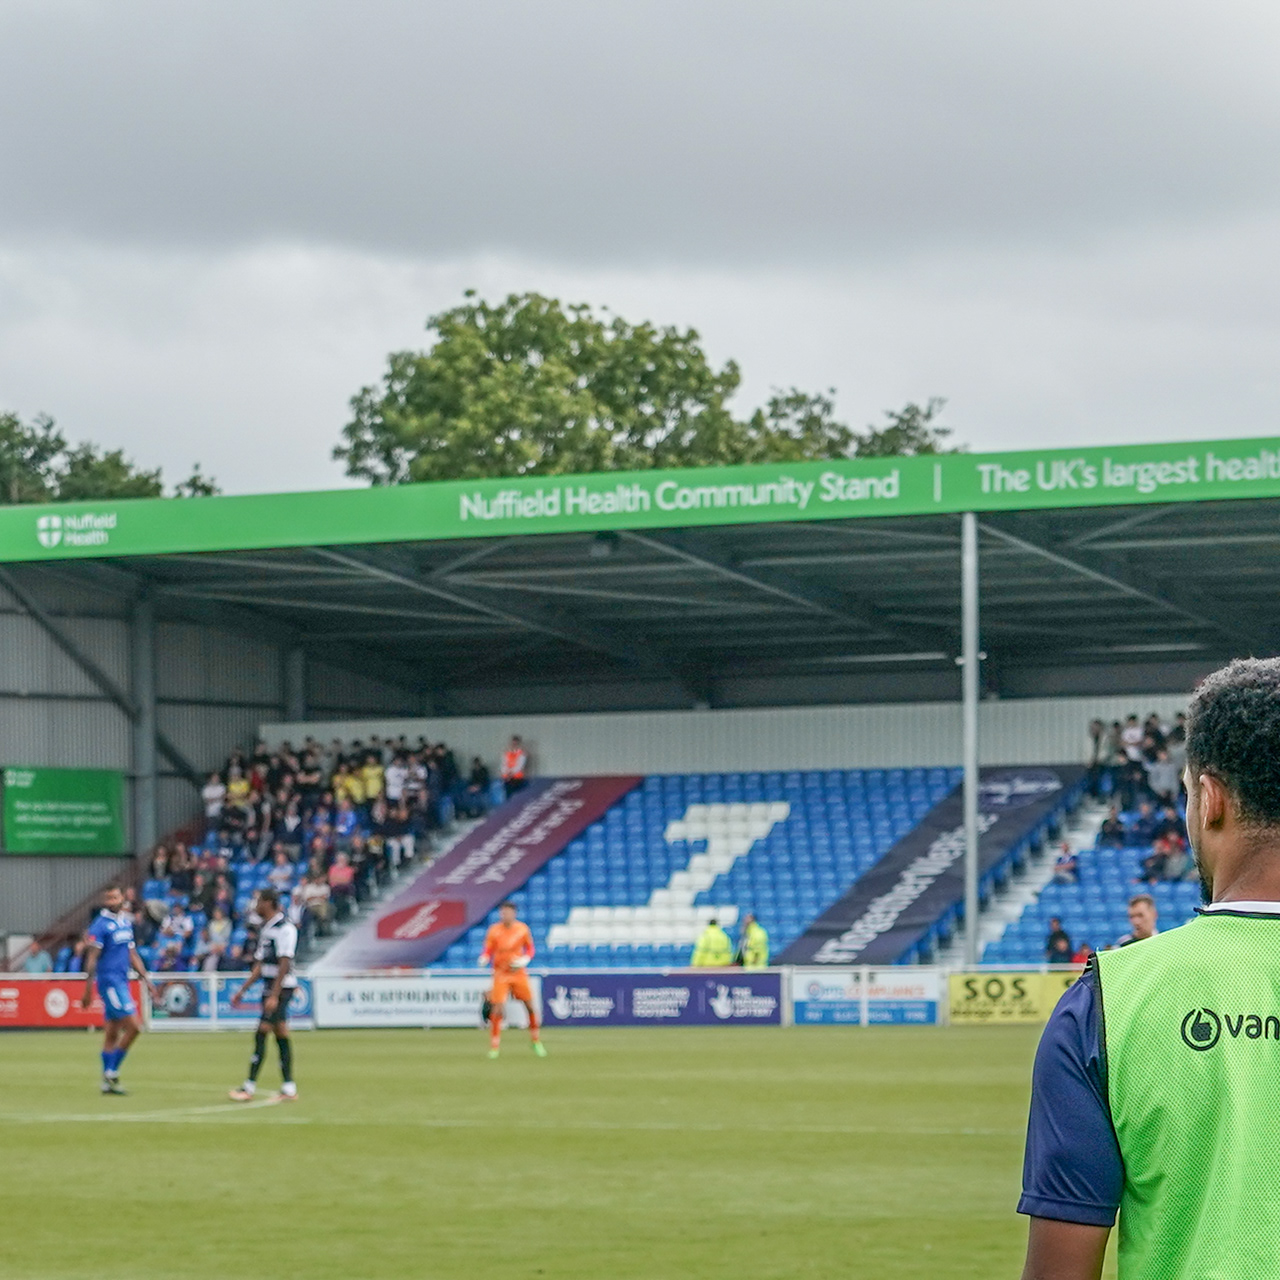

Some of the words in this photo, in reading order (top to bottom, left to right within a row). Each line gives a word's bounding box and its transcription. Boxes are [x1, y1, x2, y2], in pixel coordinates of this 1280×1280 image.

[976, 463, 1030, 494] The
[1036, 459, 1097, 490] UK's
[1103, 453, 1199, 494] largest
[459, 487, 561, 521] Nuffield
[565, 482, 650, 516] Health
[654, 475, 814, 510] Community
[818, 468, 899, 501] Stand
[63, 511, 117, 530] Nuffield
[63, 530, 109, 546] Health
[965, 978, 1027, 1001] SOS
